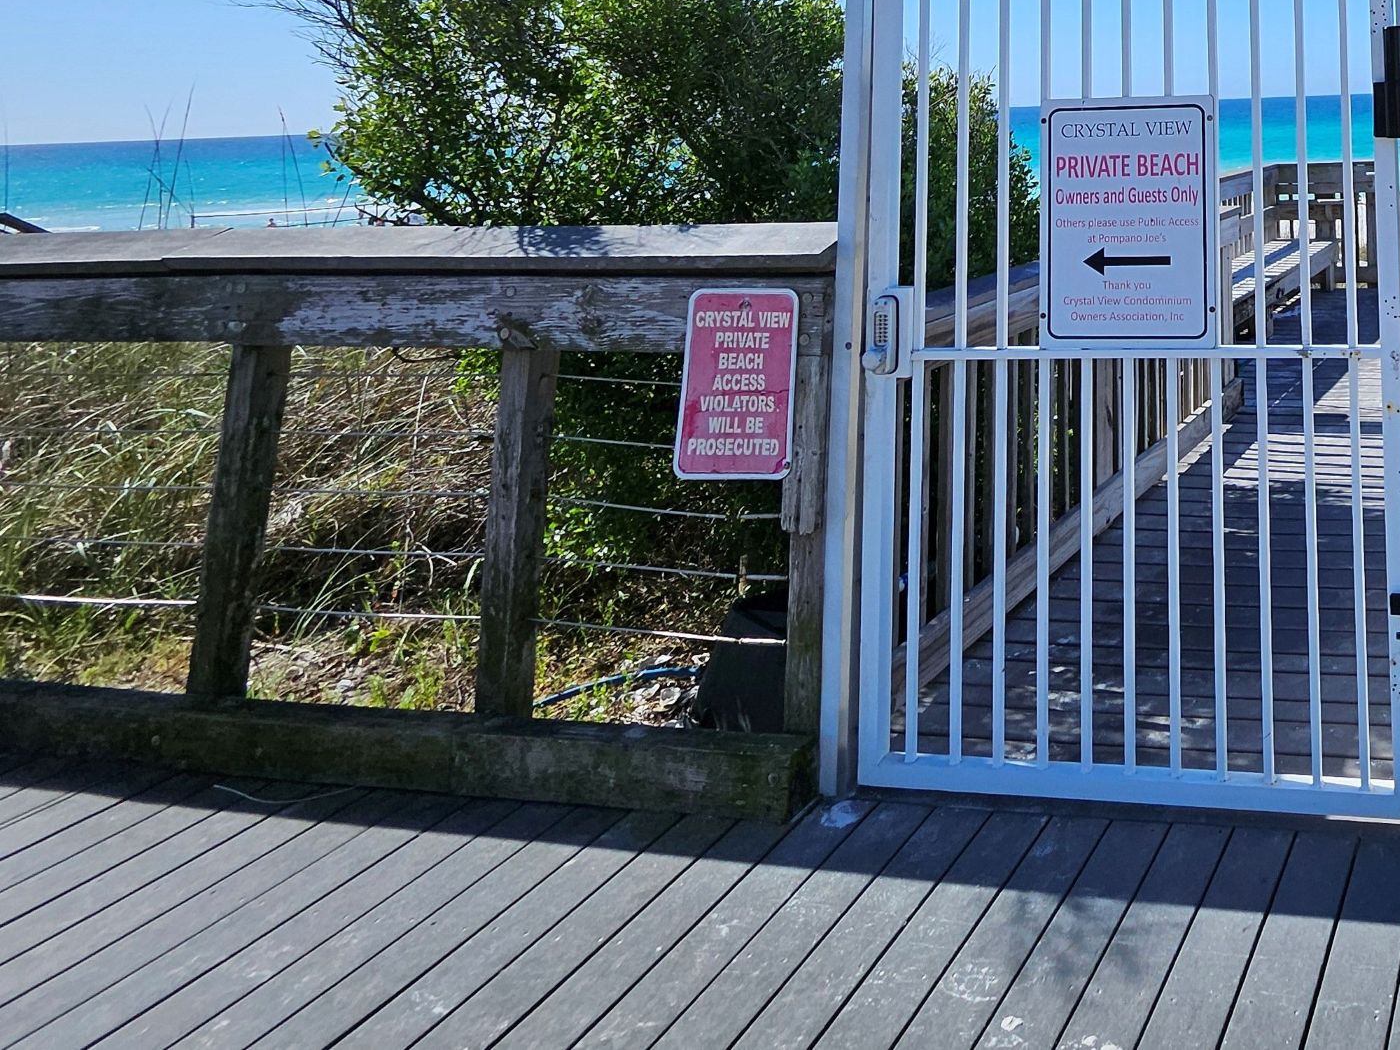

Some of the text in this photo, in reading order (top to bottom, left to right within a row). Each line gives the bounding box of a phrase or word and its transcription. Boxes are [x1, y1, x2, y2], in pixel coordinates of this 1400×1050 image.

[1061, 120, 1192, 138] CRYSTAL VIEW
[1056, 153, 1199, 178] PRIVATE BEACH
[1056, 185, 1198, 206] Owners and Guests Only
[1056, 219, 1085, 228] Others
[1088, 218, 1117, 229] please
[1138, 218, 1165, 227] Public
[1169, 217, 1199, 227] Access
[1088, 235, 1096, 243] at
[1099, 234, 1142, 245] Pompano
[1103, 281, 1151, 291] Thank you
[1063, 296, 1192, 307] Crystal View Condominium
[696, 312, 790, 328] CRYSTAL VIEW
[1071, 311, 1184, 322] Owners Association, Inc
[715, 333, 769, 348] PRIVATE
[719, 353, 763, 369] BEACH
[712, 374, 765, 390] ACCESS
[709, 417, 763, 433] WILL BE
[687, 438, 779, 456] PROSECUTED
